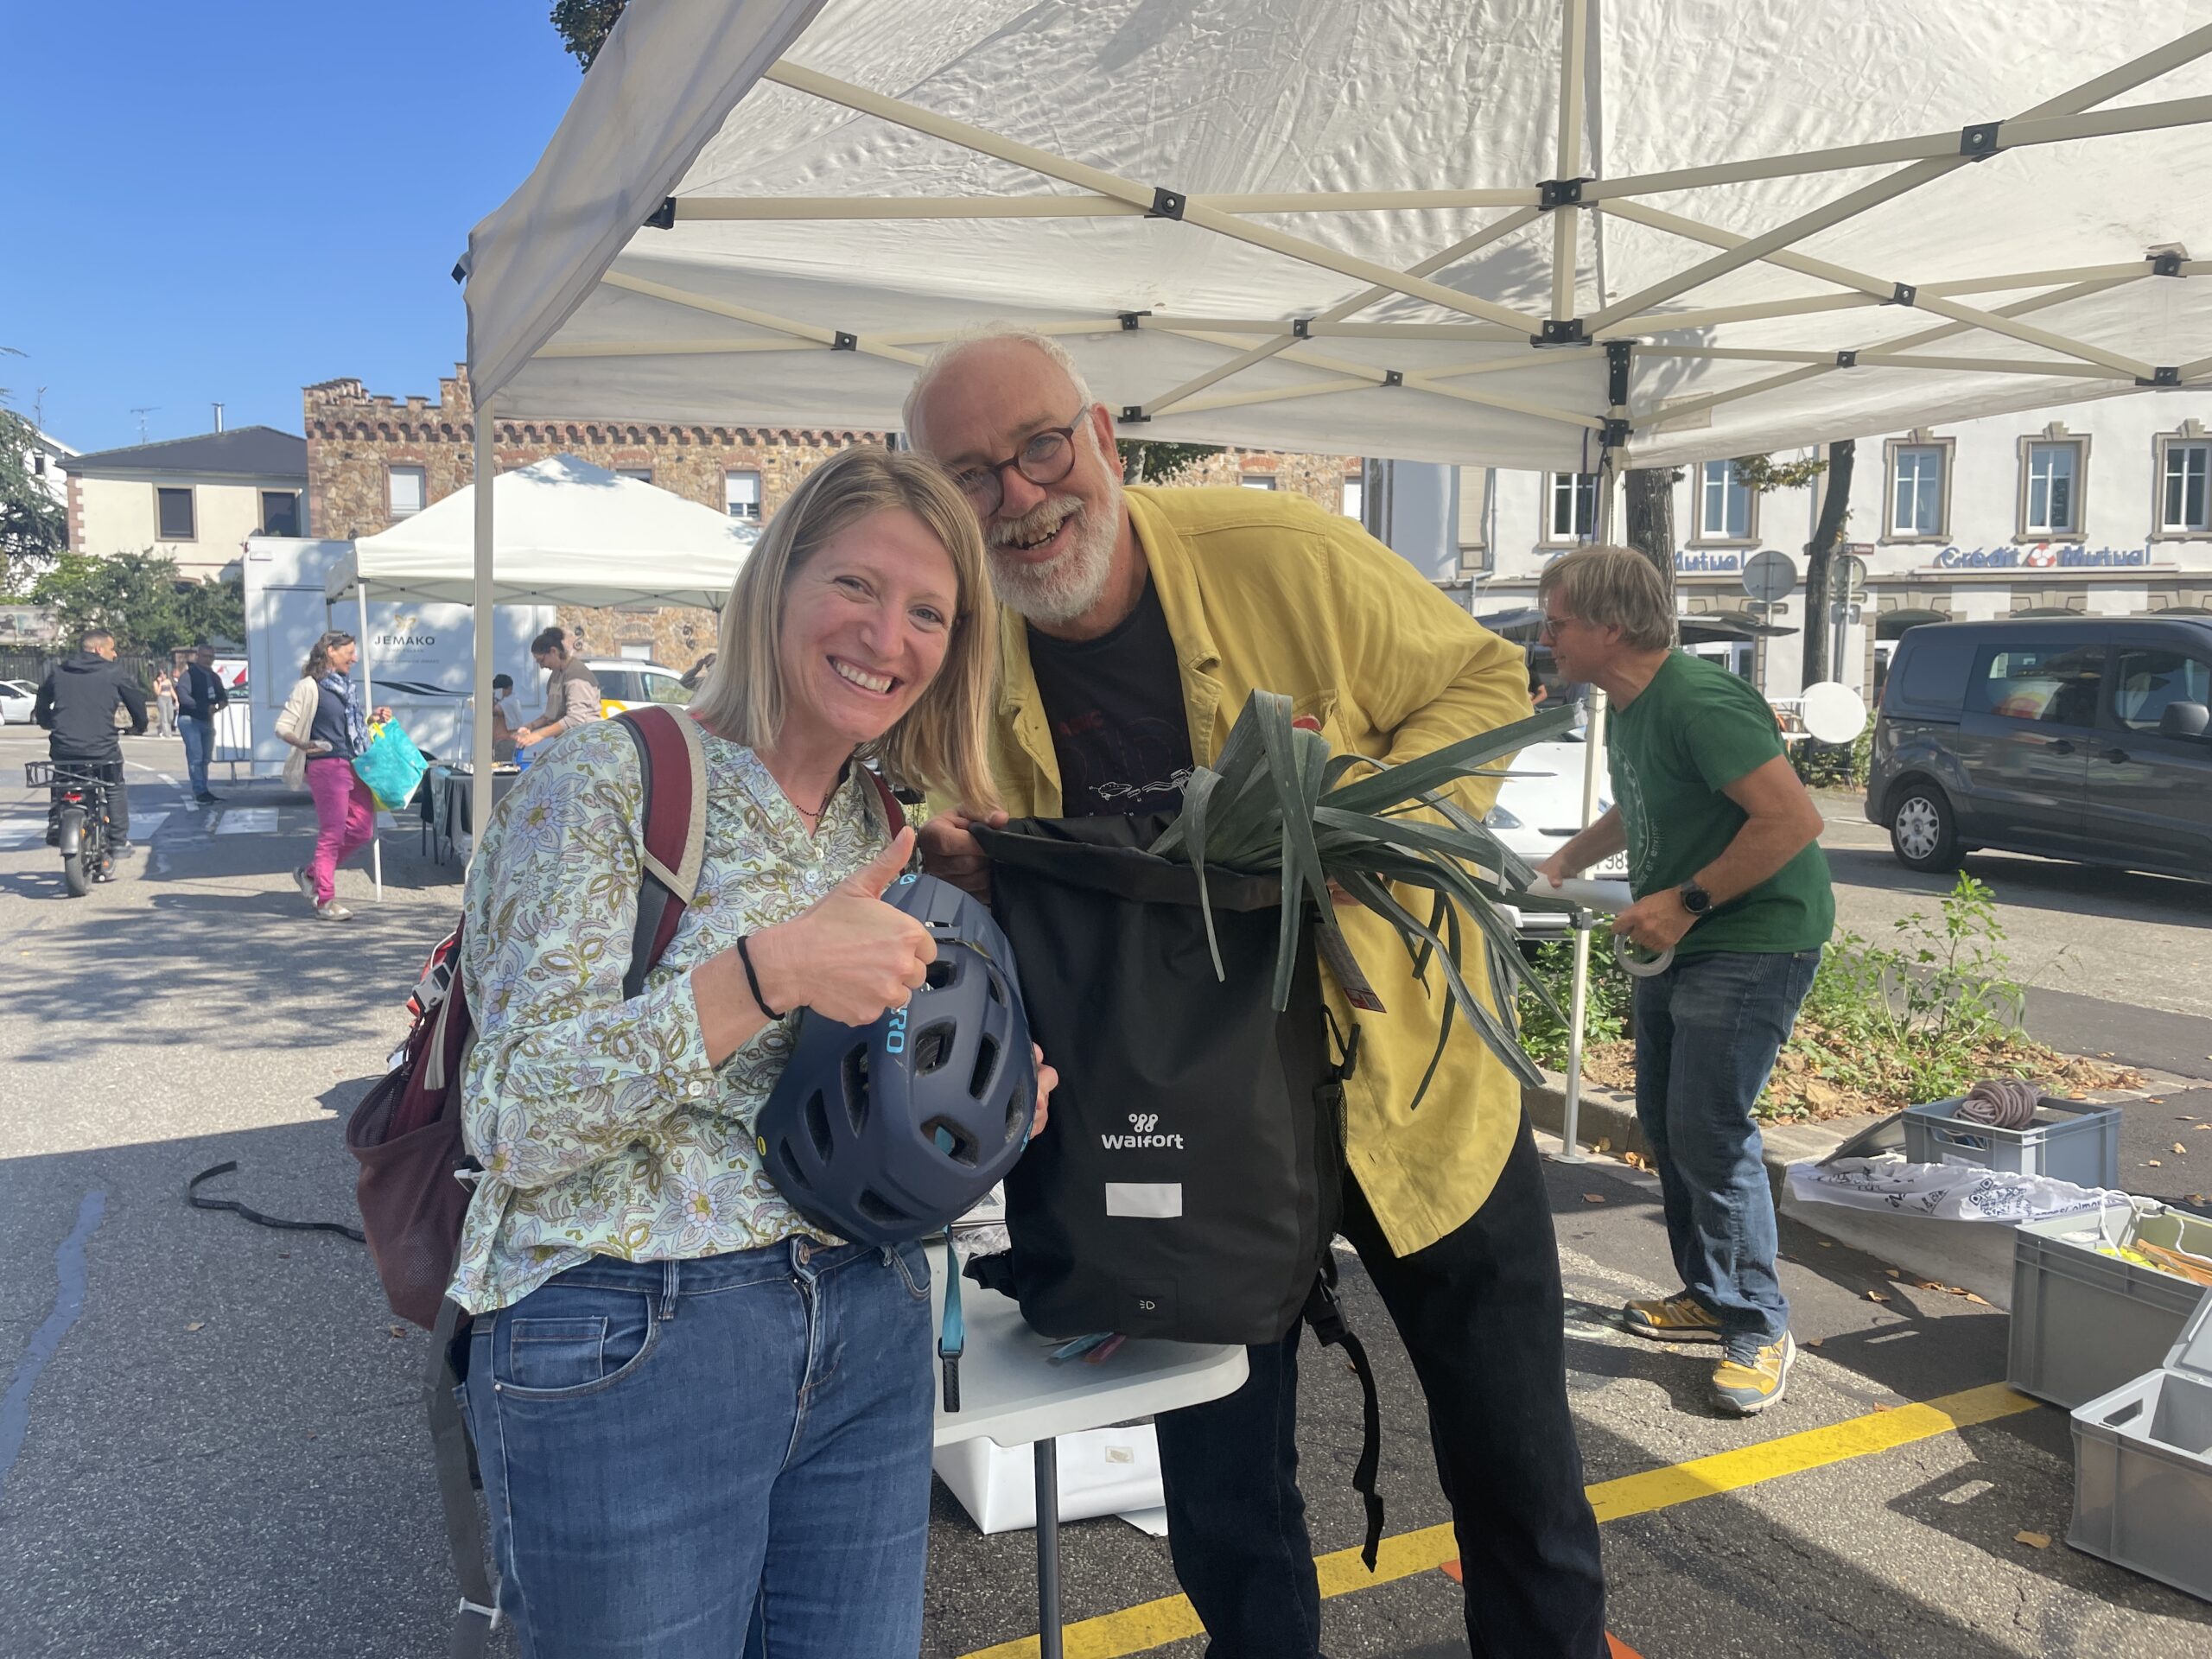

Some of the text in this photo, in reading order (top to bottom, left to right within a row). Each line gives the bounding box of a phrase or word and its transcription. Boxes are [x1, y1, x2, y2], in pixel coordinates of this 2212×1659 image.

[1941, 543, 2152, 568] Crédit Mutuel
[374, 635, 435, 646] JEMAKO
[886, 1007, 908, 1053] RO
[1101, 1134, 1184, 1150] Walfort
